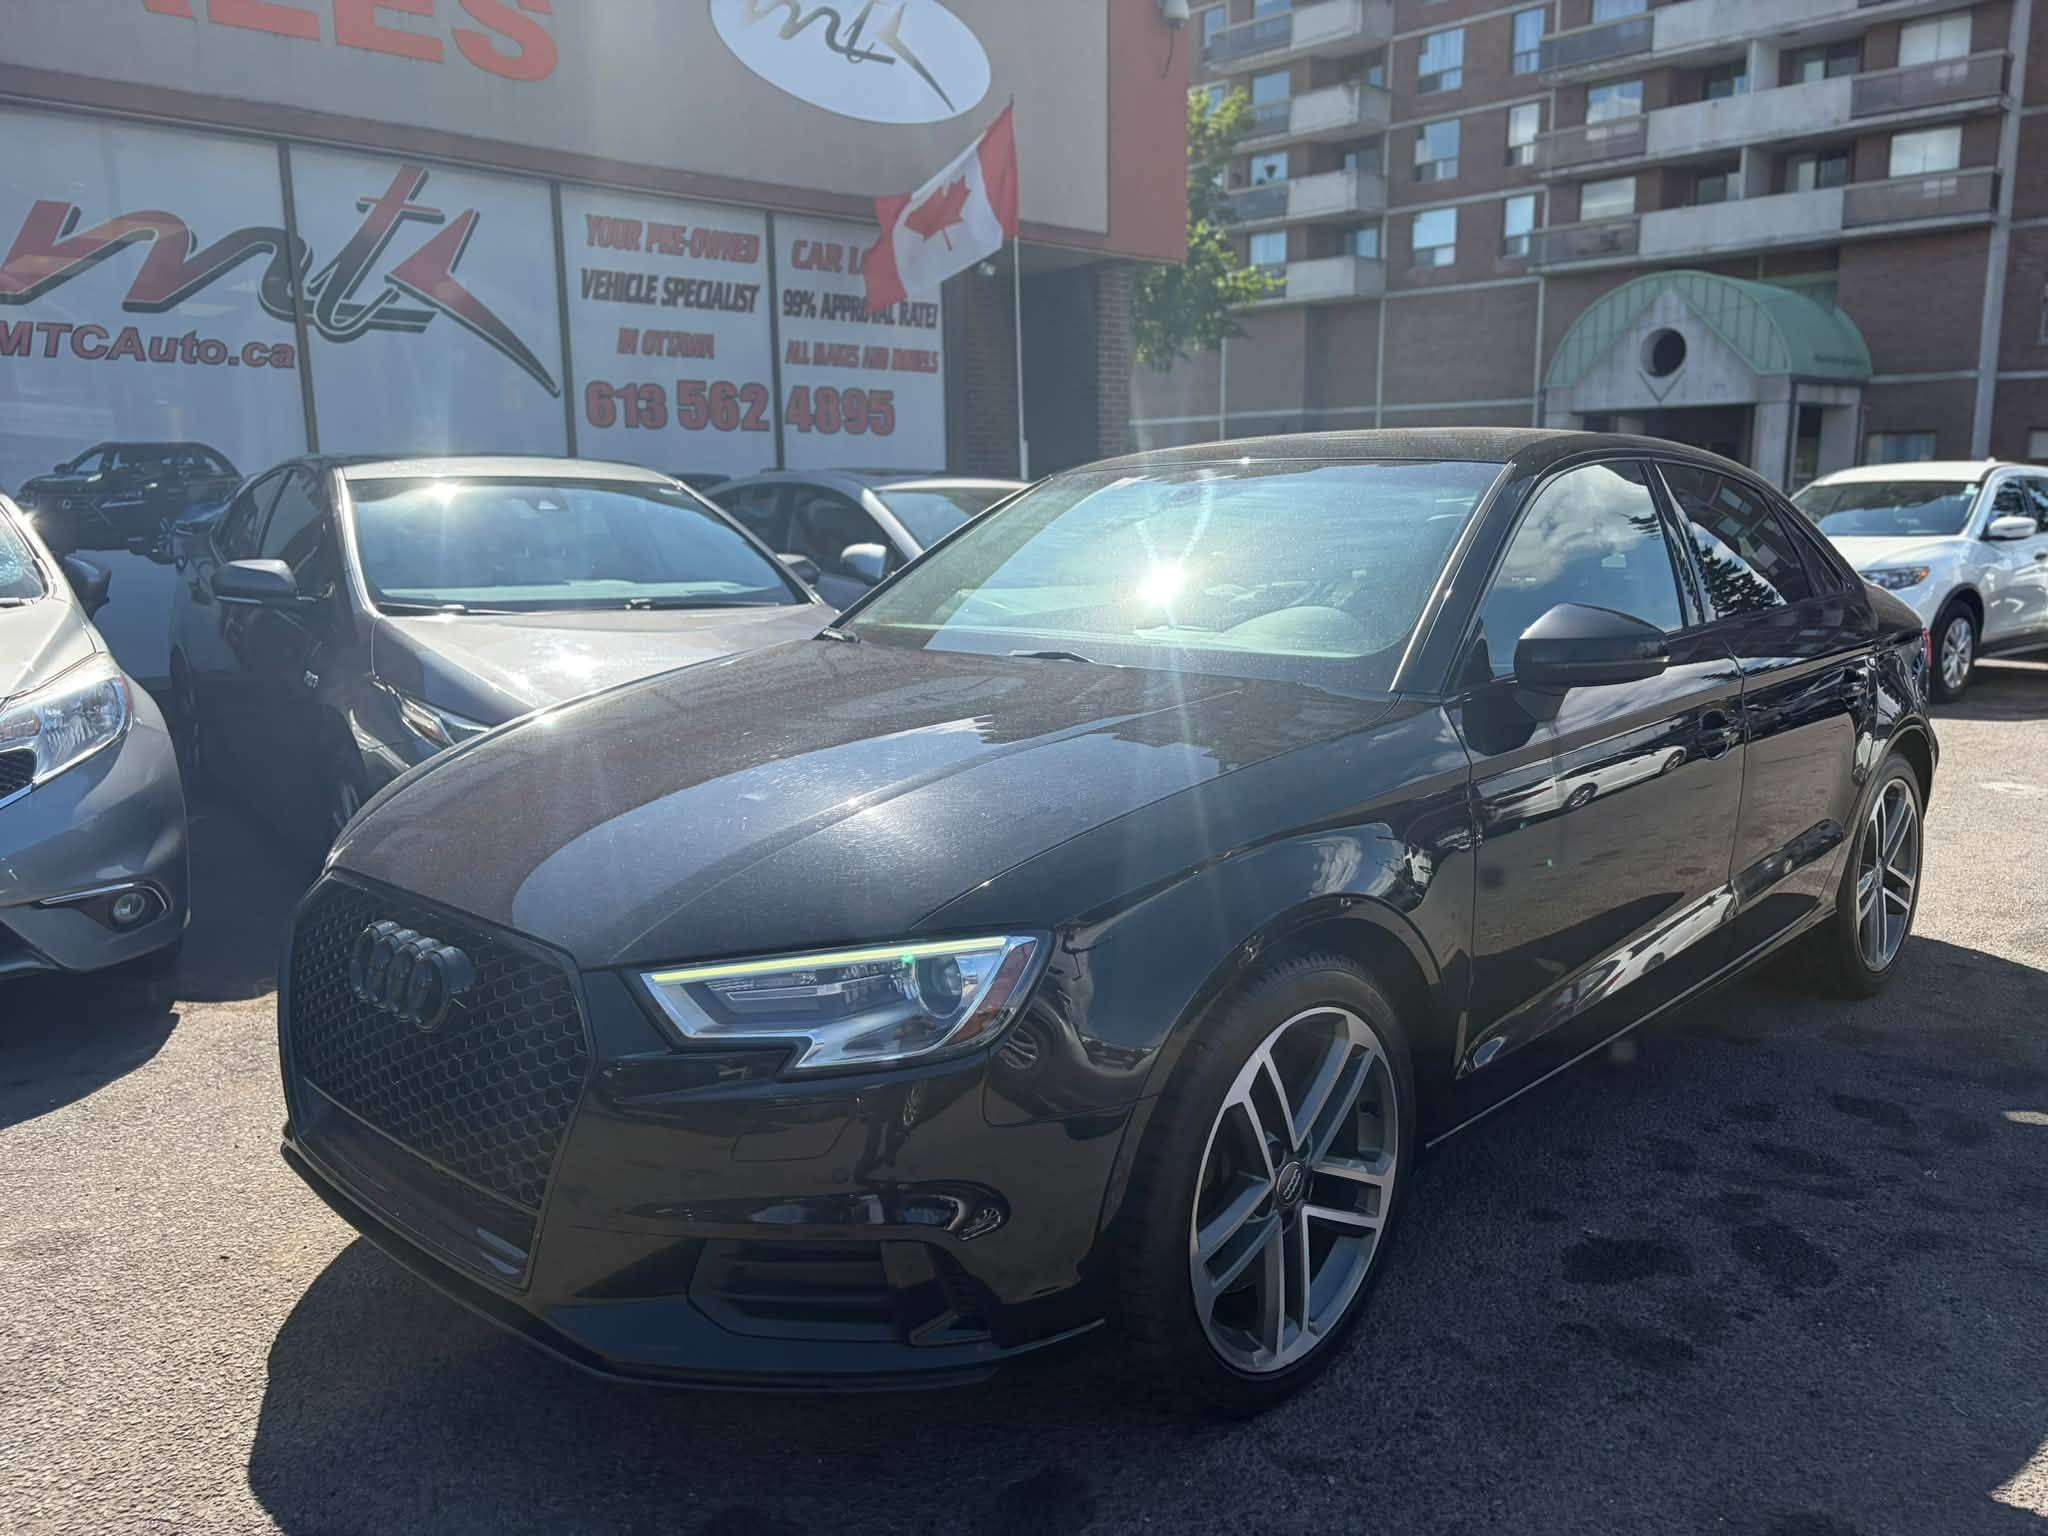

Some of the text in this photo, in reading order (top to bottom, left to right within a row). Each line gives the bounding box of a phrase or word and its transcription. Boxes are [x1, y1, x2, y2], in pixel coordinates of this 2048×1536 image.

[791, 239, 843, 273] CAR
[581, 267, 760, 313] VEHICLE SPECIALIST
[783, 289, 816, 319] 99%
[0, 320, 296, 369] MTCAuto.ca
[584, 379, 896, 436] 613 562 4895
